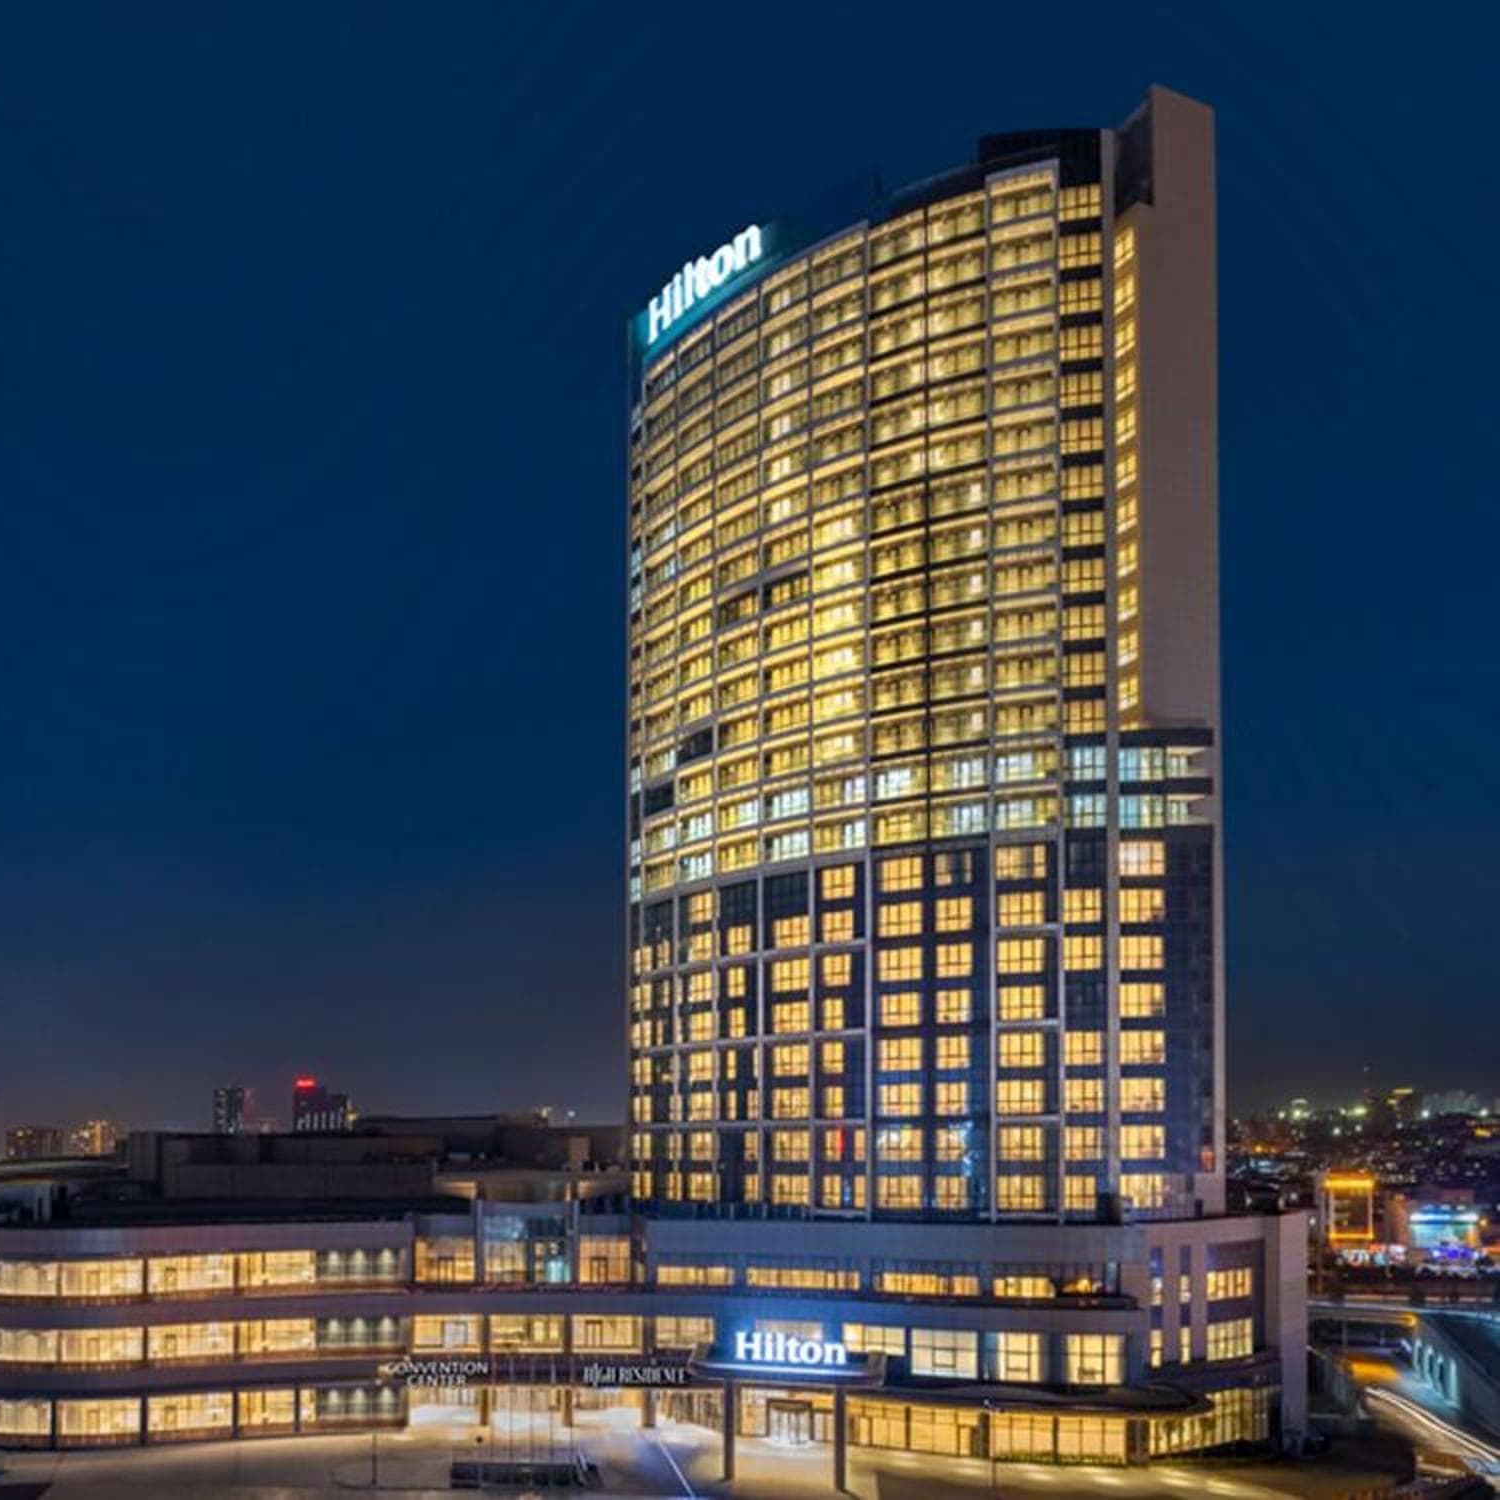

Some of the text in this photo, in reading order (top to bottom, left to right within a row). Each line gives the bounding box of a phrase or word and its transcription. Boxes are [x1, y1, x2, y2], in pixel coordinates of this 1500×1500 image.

[647, 223, 763, 345] Hilton
[735, 1331, 847, 1365] Hilton
[387, 1361, 489, 1376] CONVENTION
[618, 1366, 686, 1384] RESIDENCE
[406, 1374, 467, 1387] CENTER
